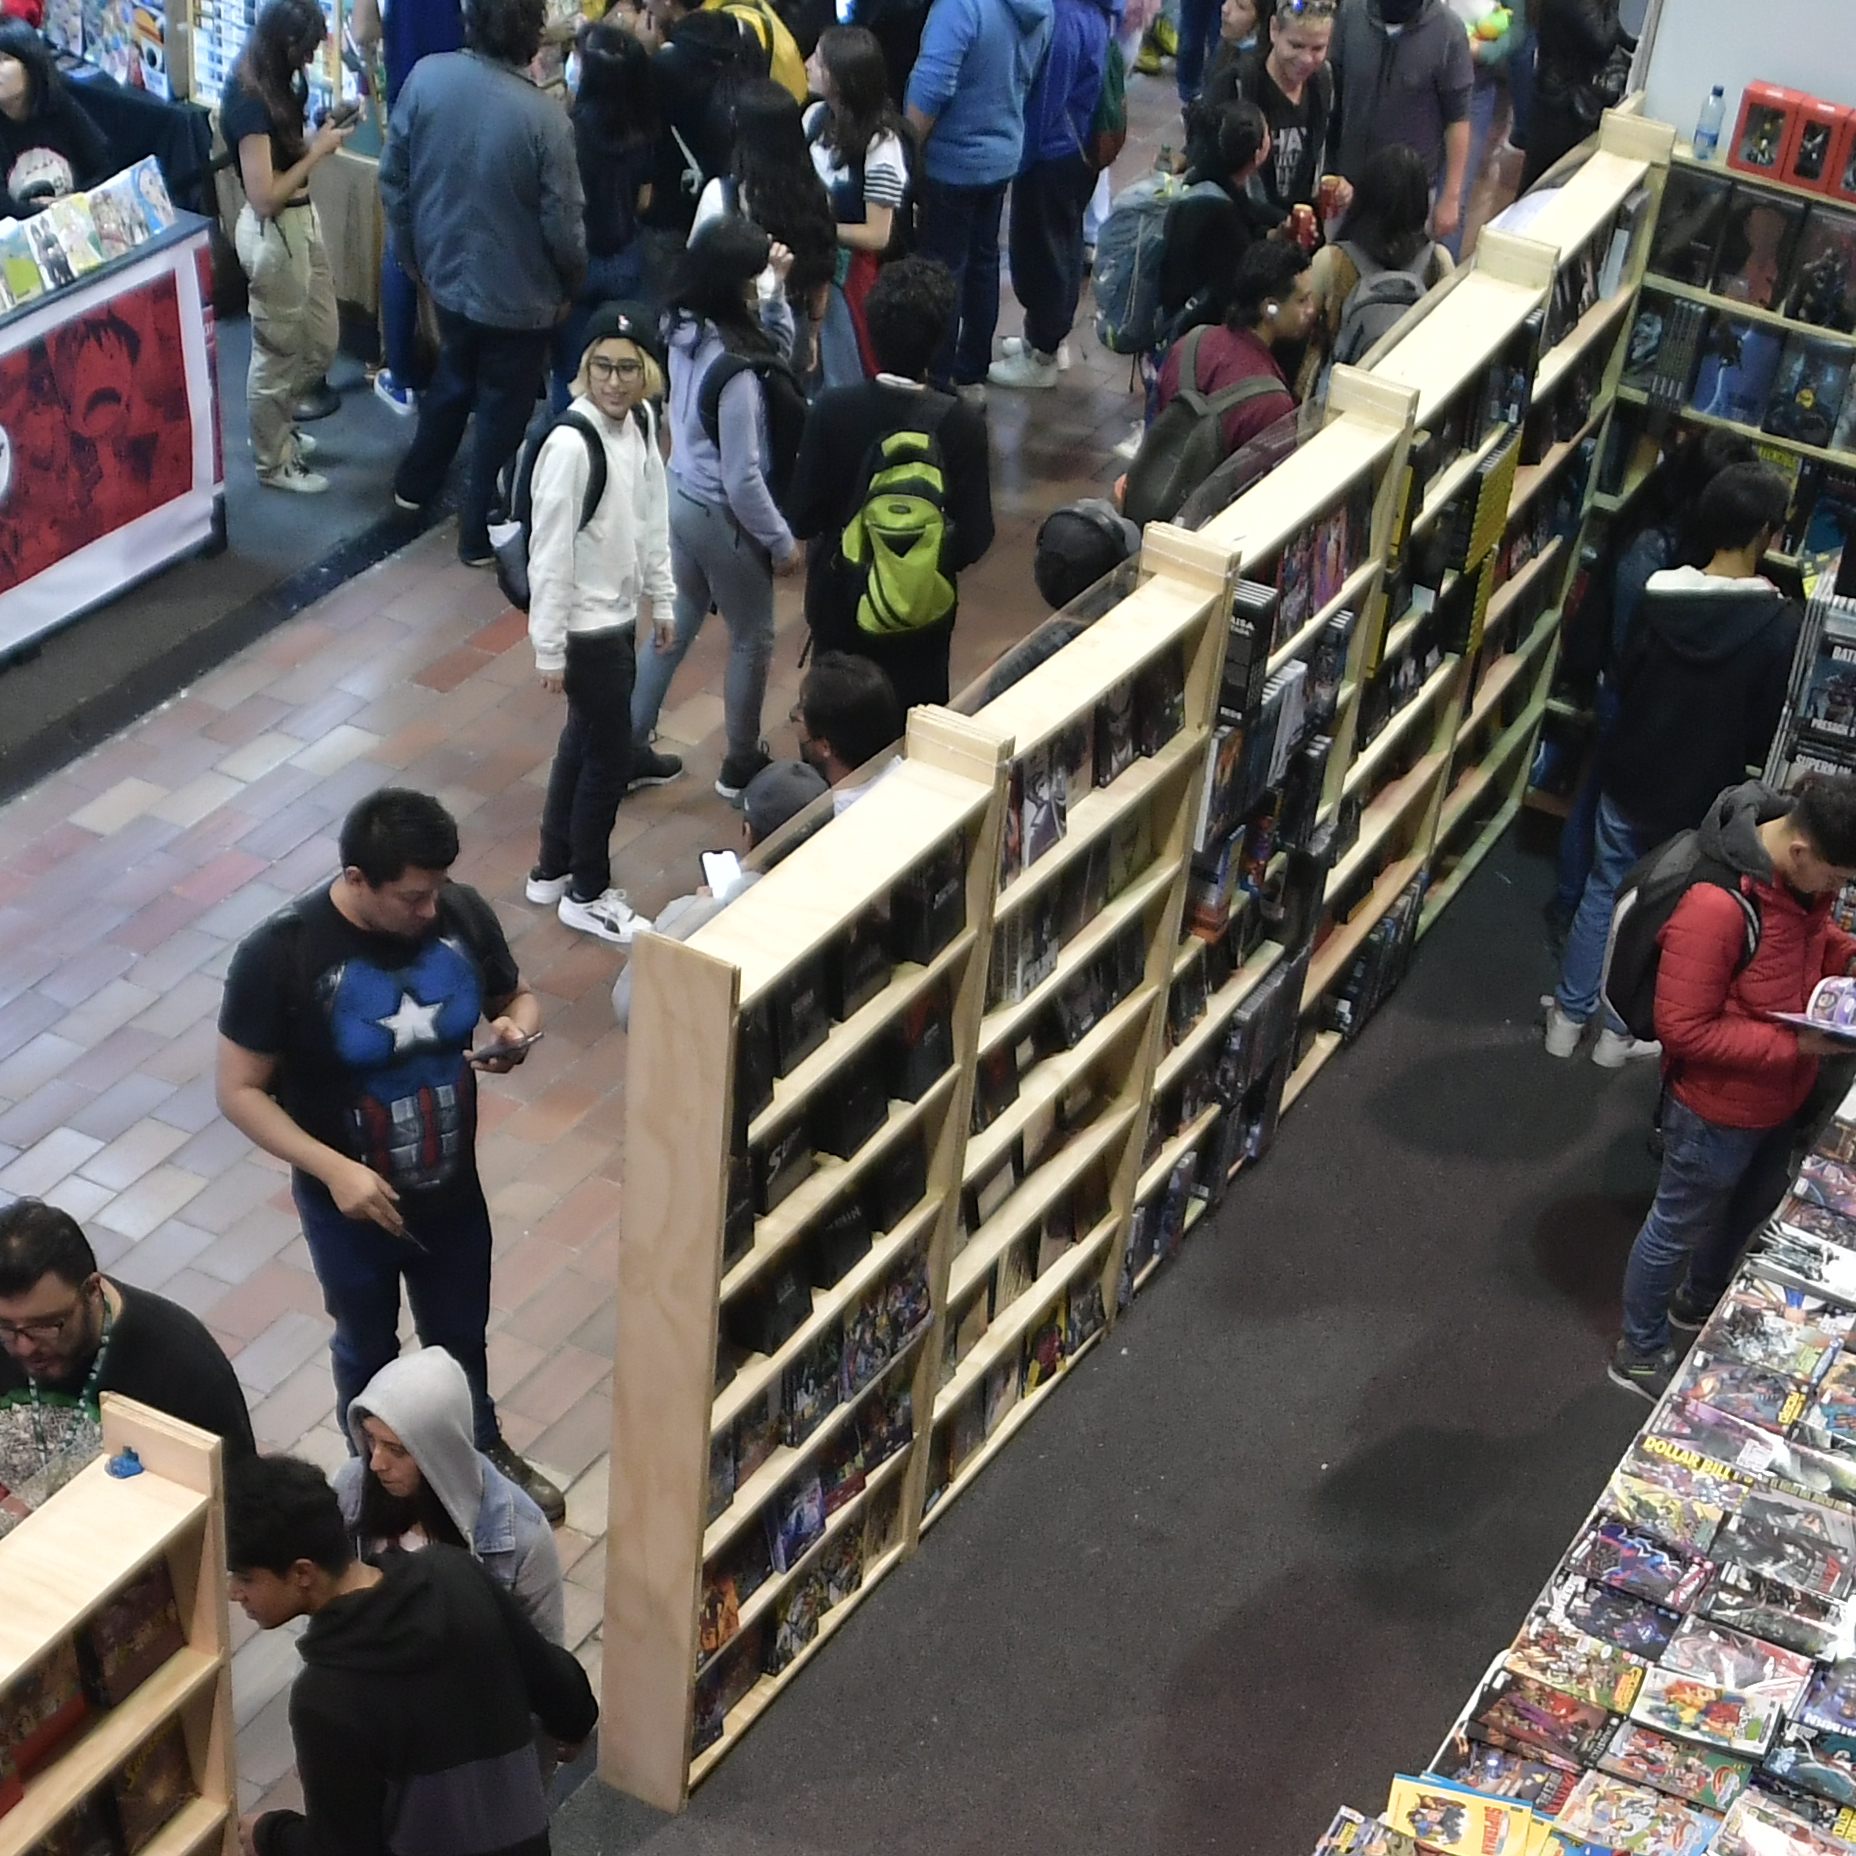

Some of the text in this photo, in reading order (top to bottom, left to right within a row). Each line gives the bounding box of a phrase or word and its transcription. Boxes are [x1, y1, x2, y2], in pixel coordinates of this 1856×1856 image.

[1643, 1435, 1733, 1480] DOLLAR BILL
[1481, 1805, 1503, 1856] SUPERMAN
